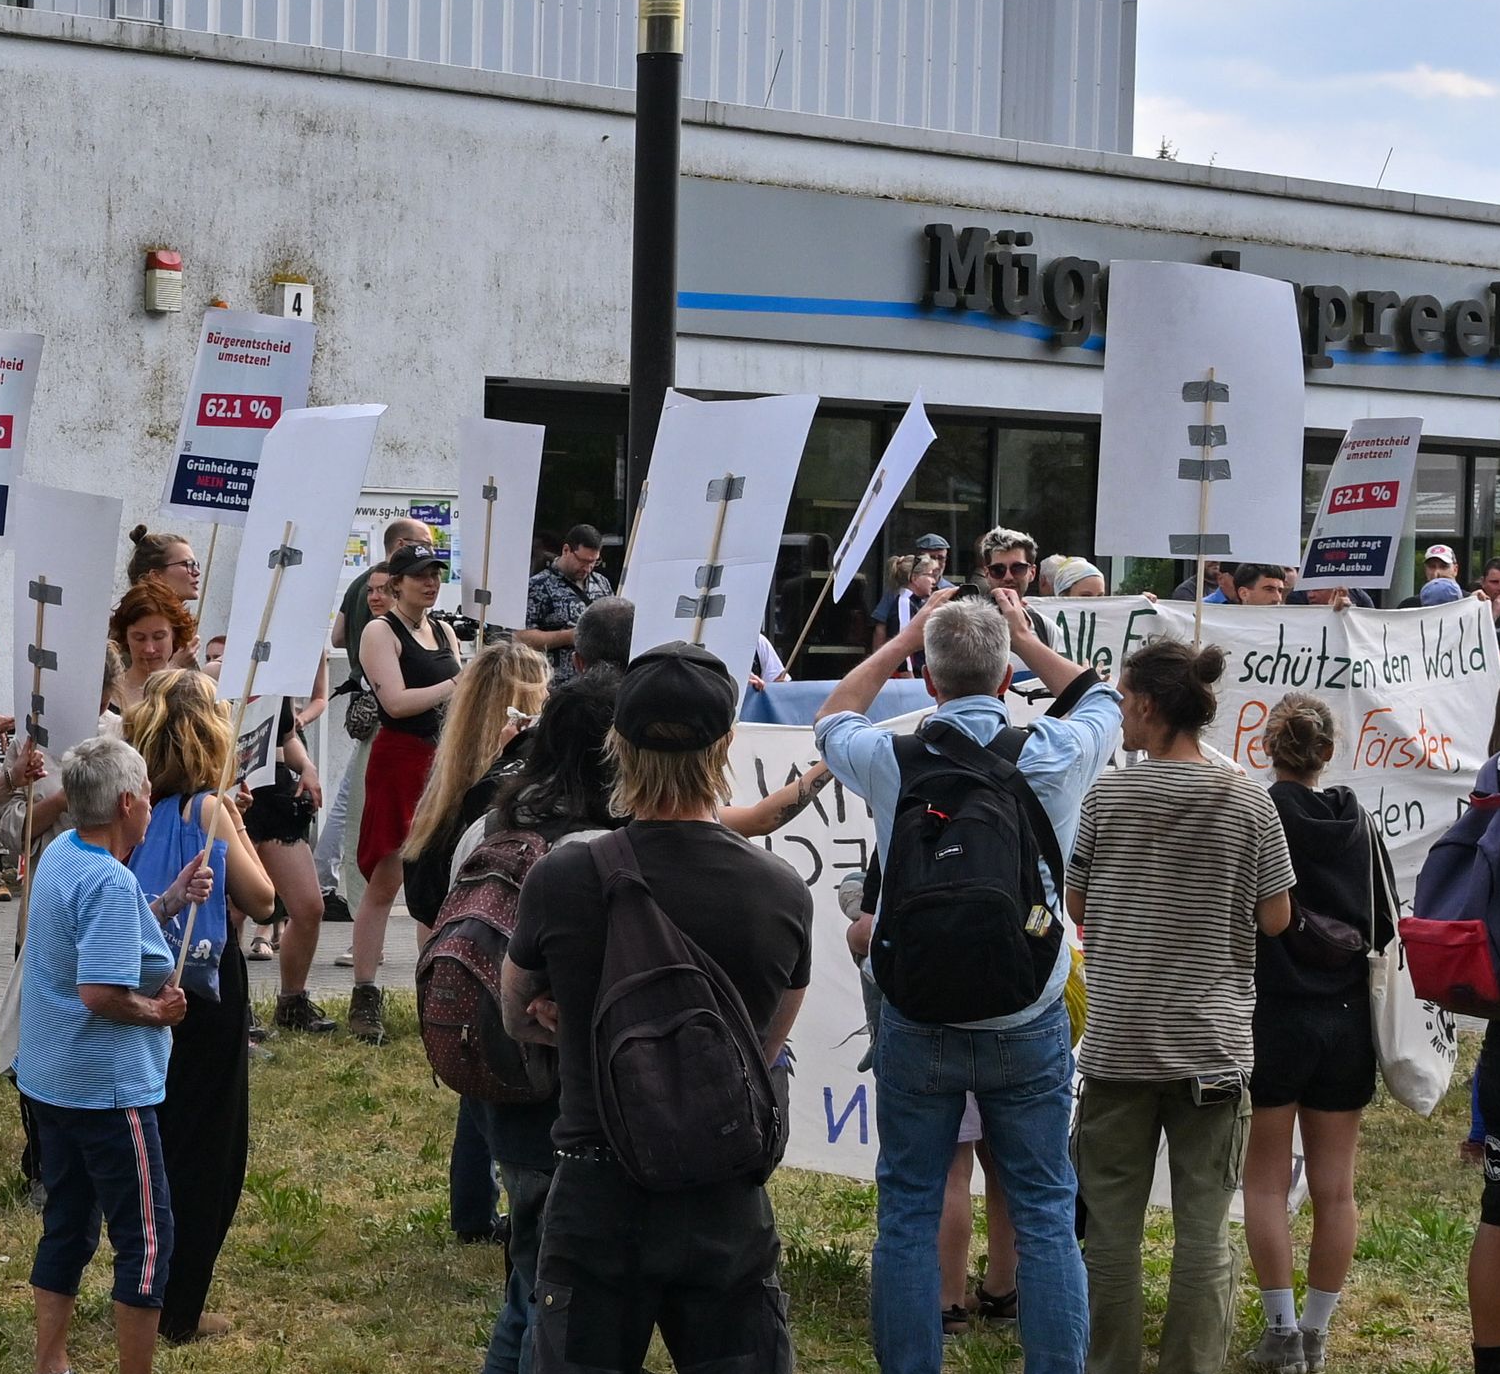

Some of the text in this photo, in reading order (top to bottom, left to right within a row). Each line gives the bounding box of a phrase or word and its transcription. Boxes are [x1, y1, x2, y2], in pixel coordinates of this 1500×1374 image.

[292, 292, 302, 317] 4
[206, 332, 291, 354] Bürgerentscheid
[218, 352, 271, 367] umsetzen!
[205, 398, 272, 420] 62.1 %
[187, 459, 258, 480] Grünheide sag
[196, 475, 248, 491] NEIN zum
[1335, 486, 1391, 506] 62.1 %
[1317, 539, 1381, 551] Grünheide sagt
[1315, 563, 1373, 573] Tesla-Ausbau
[1056, 609, 1113, 675] Alle
[1239, 623, 1376, 689] schützen
[1381, 630, 1411, 685] den
[1420, 608, 1487, 681] Wald
